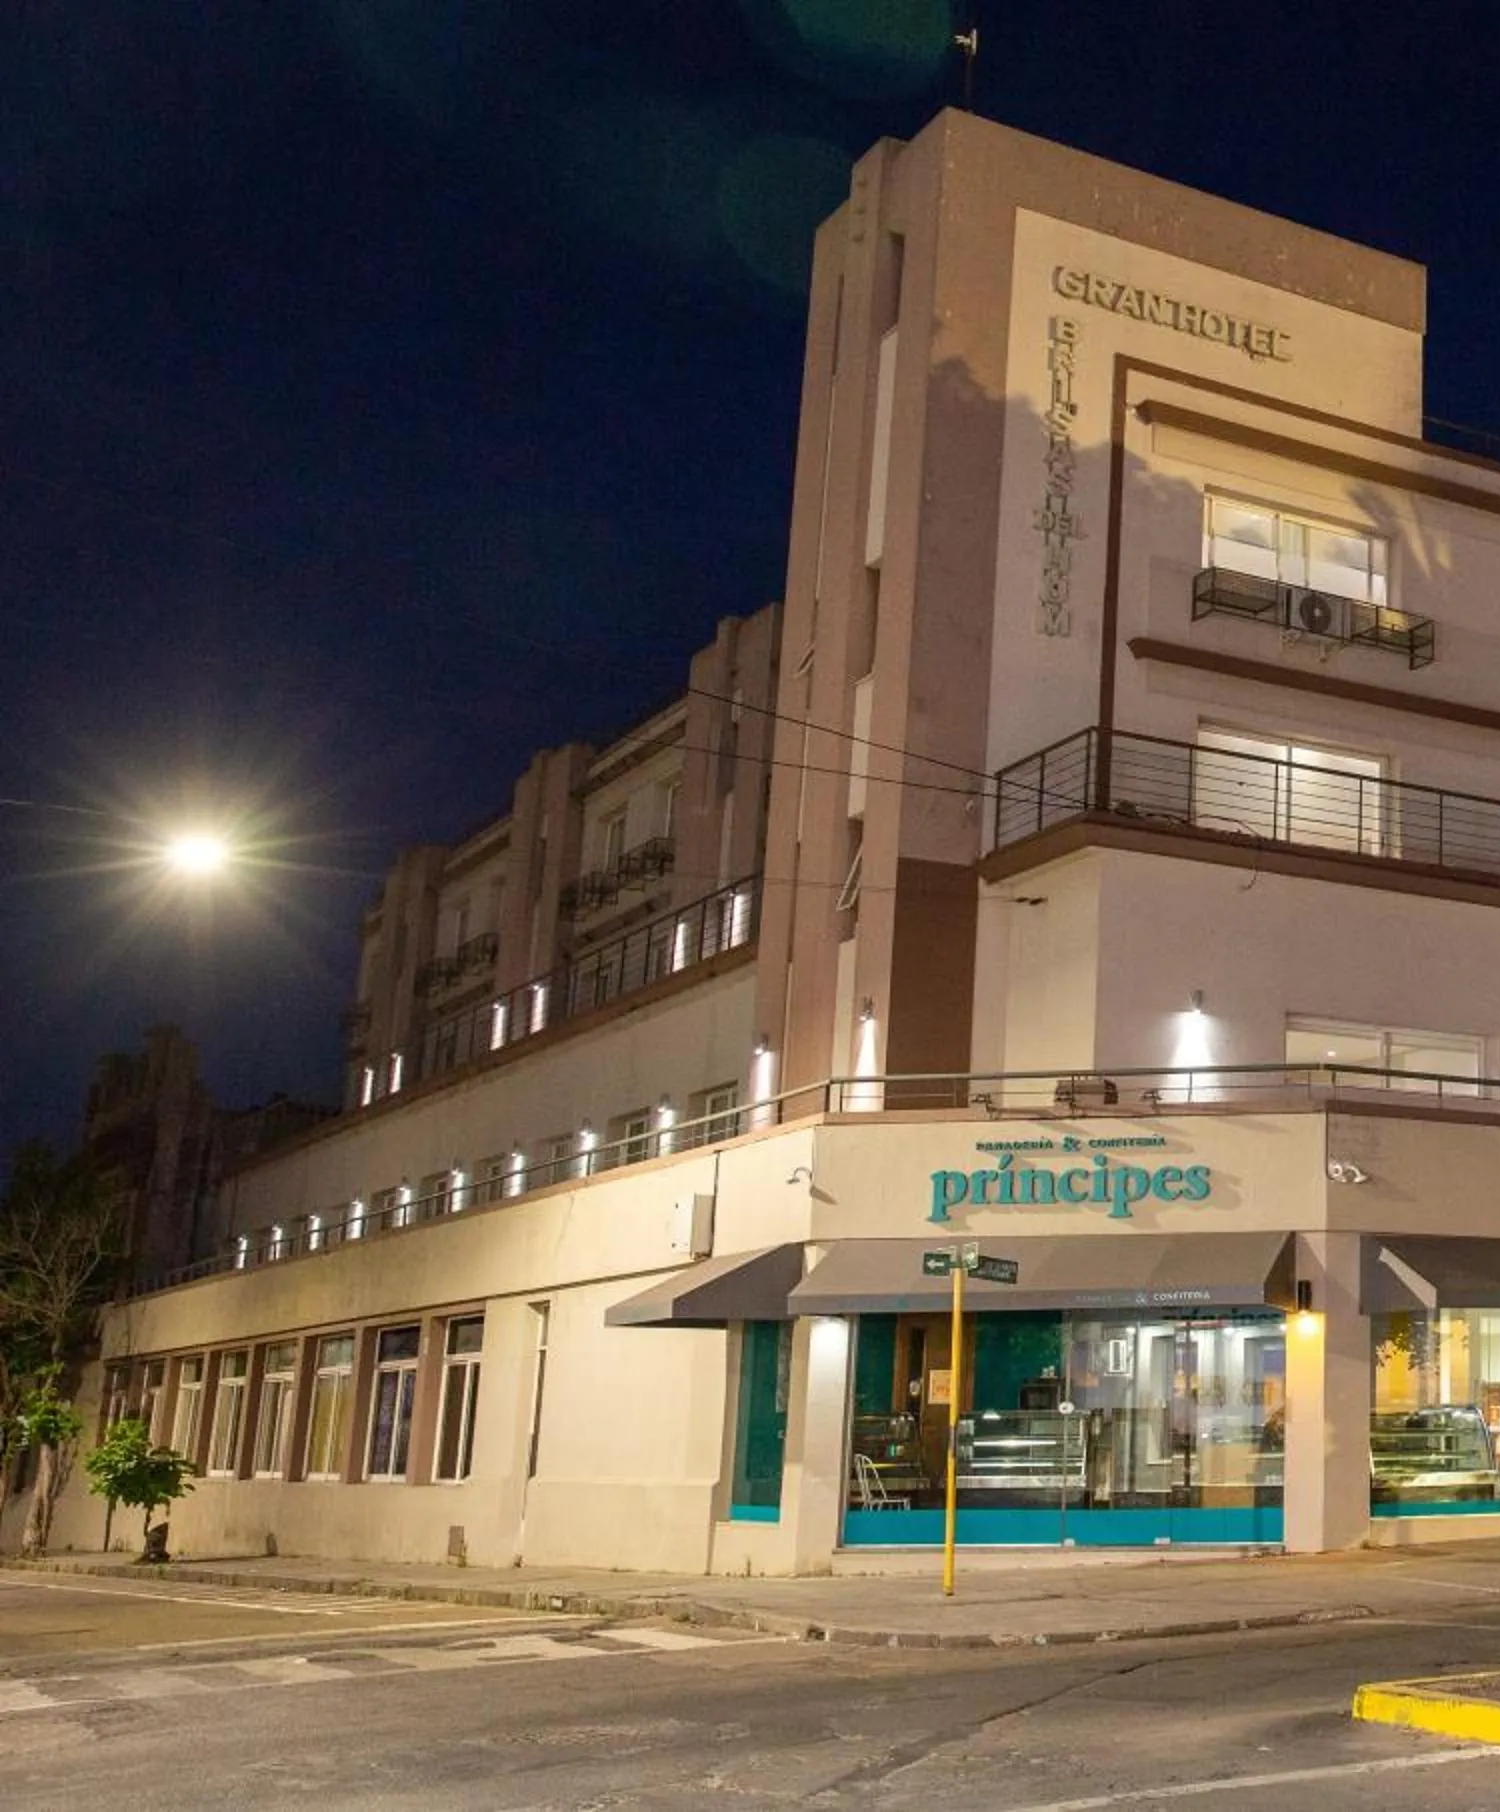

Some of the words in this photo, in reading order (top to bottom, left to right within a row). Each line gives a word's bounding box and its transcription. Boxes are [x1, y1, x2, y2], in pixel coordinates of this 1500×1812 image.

[1051, 265, 1171, 326] GRAN
[1170, 299, 1293, 363] HOTEL
[1061, 1134, 1082, 1153] &
[926, 1153, 1212, 1223] príncipes
